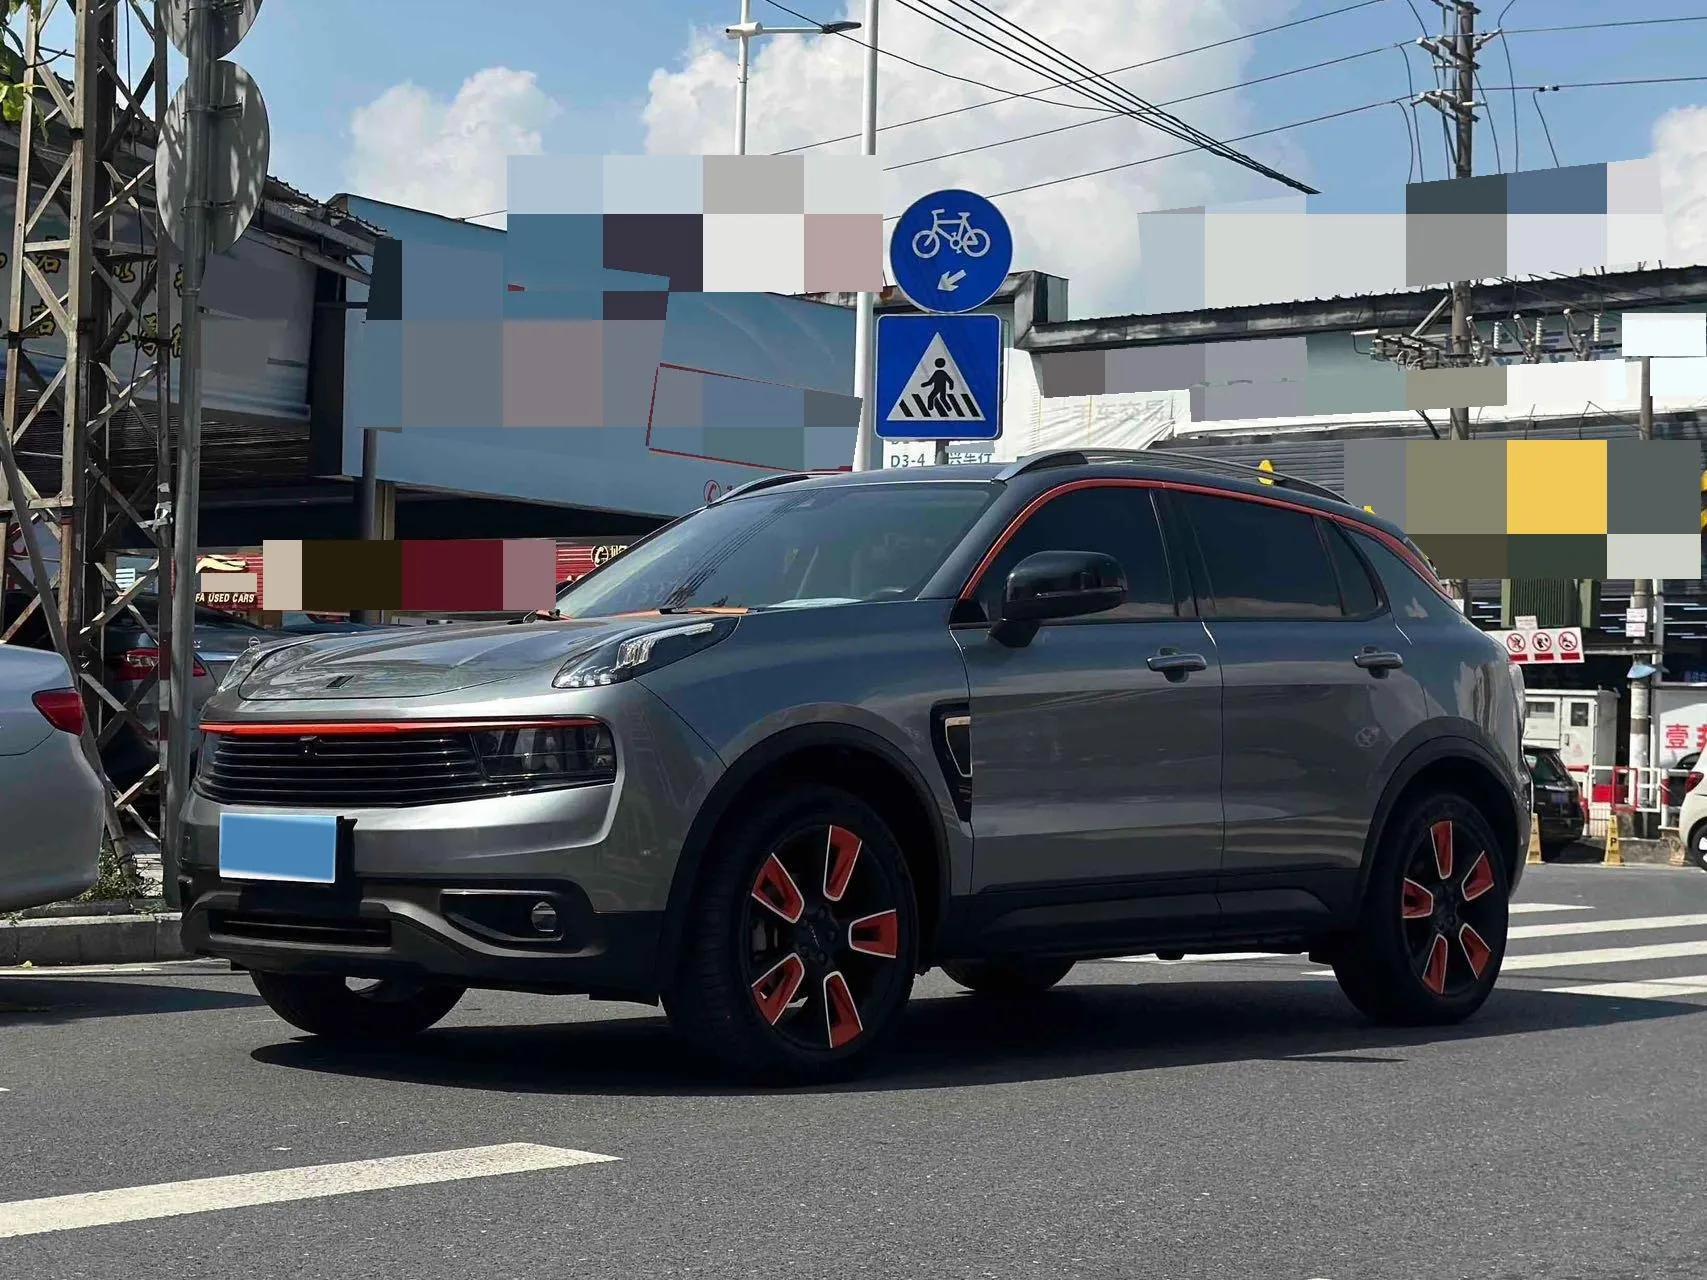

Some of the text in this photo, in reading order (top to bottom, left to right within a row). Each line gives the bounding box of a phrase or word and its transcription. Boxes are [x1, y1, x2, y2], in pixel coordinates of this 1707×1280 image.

[891, 454, 926, 468] D3-4
[208, 593, 230, 603] USED
[232, 593, 255, 603] CARS
